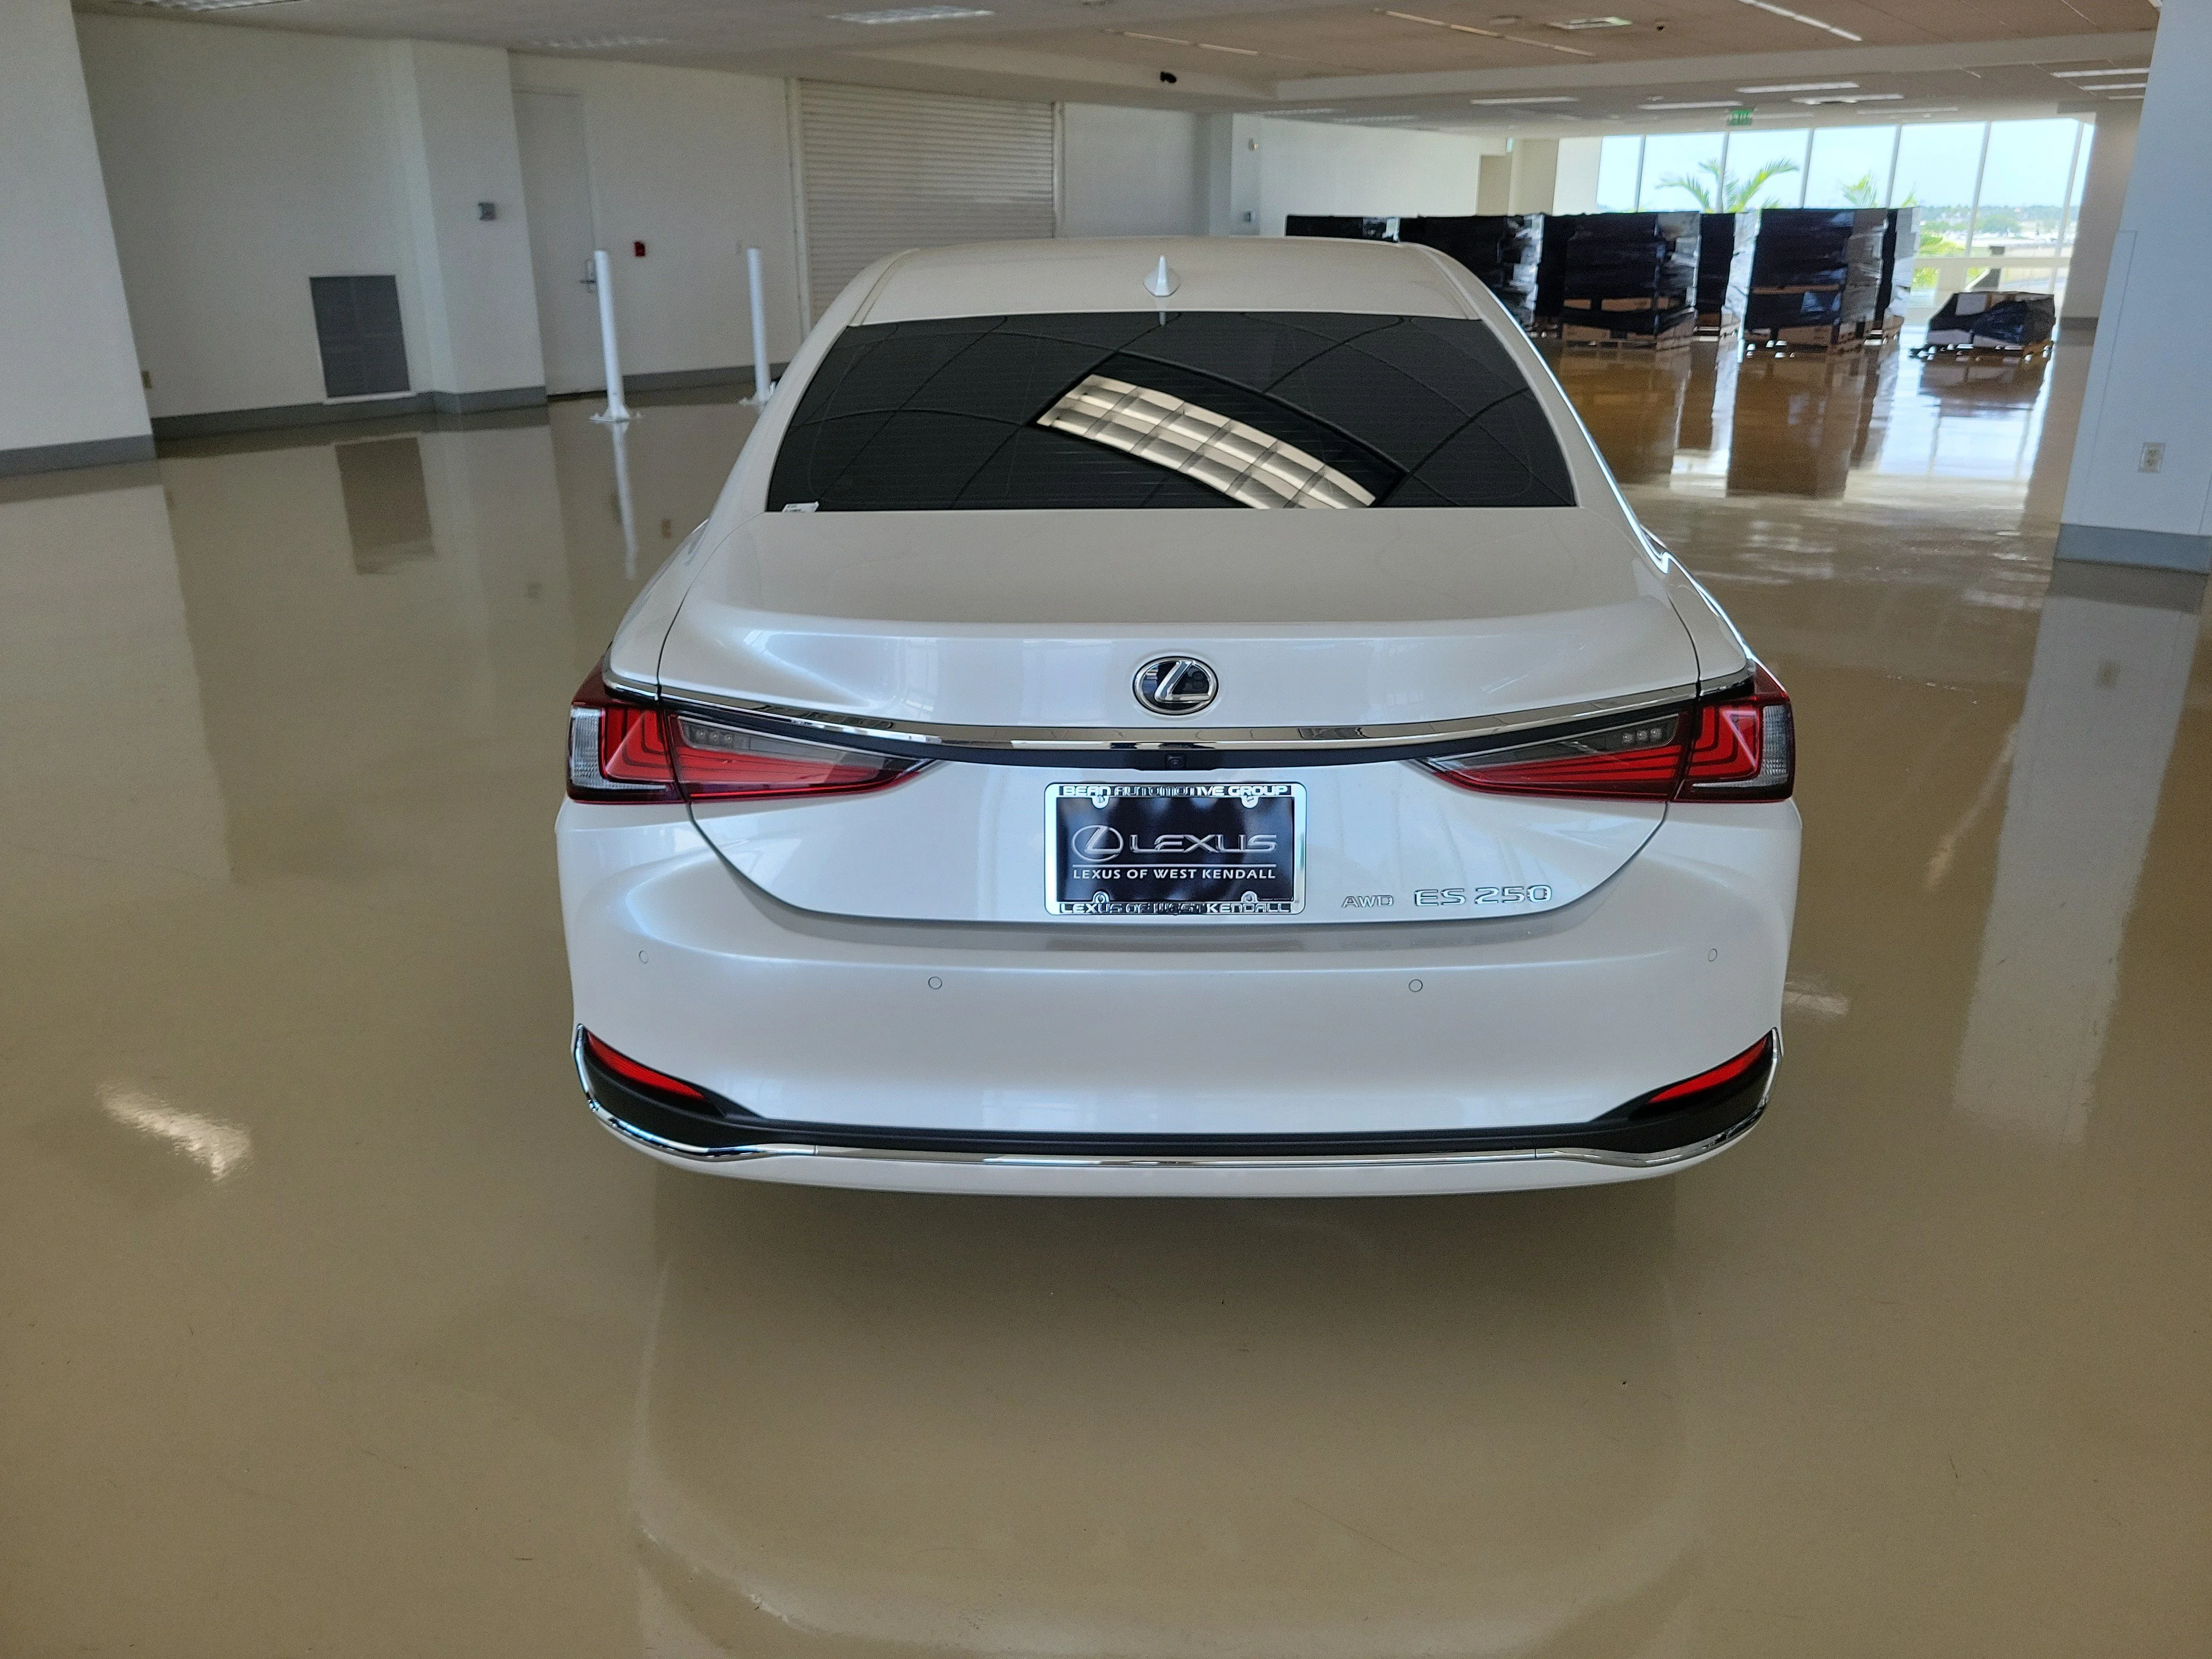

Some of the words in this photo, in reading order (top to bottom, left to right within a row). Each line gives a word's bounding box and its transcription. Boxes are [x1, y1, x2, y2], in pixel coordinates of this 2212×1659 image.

[1062, 786, 1111, 795] BEAN
[1114, 786, 1224, 796] AUTOMOTIVE
[1227, 785, 1288, 795] GROUP
[1130, 834, 1277, 853] LEXUS
[1073, 869, 1121, 879] LEXUS
[1126, 869, 1148, 879] OF
[1153, 869, 1197, 879] WEST
[1201, 868, 1276, 879] KENDALL
[1341, 895, 1394, 908] AWD
[1414, 889, 1466, 906] ES
[1475, 885, 1553, 904] 250
[1060, 903, 1122, 913] LEXUS
[1125, 903, 1150, 913] OF
[1153, 903, 1204, 913] WEST
[1207, 902, 1291, 913] KENDALL
